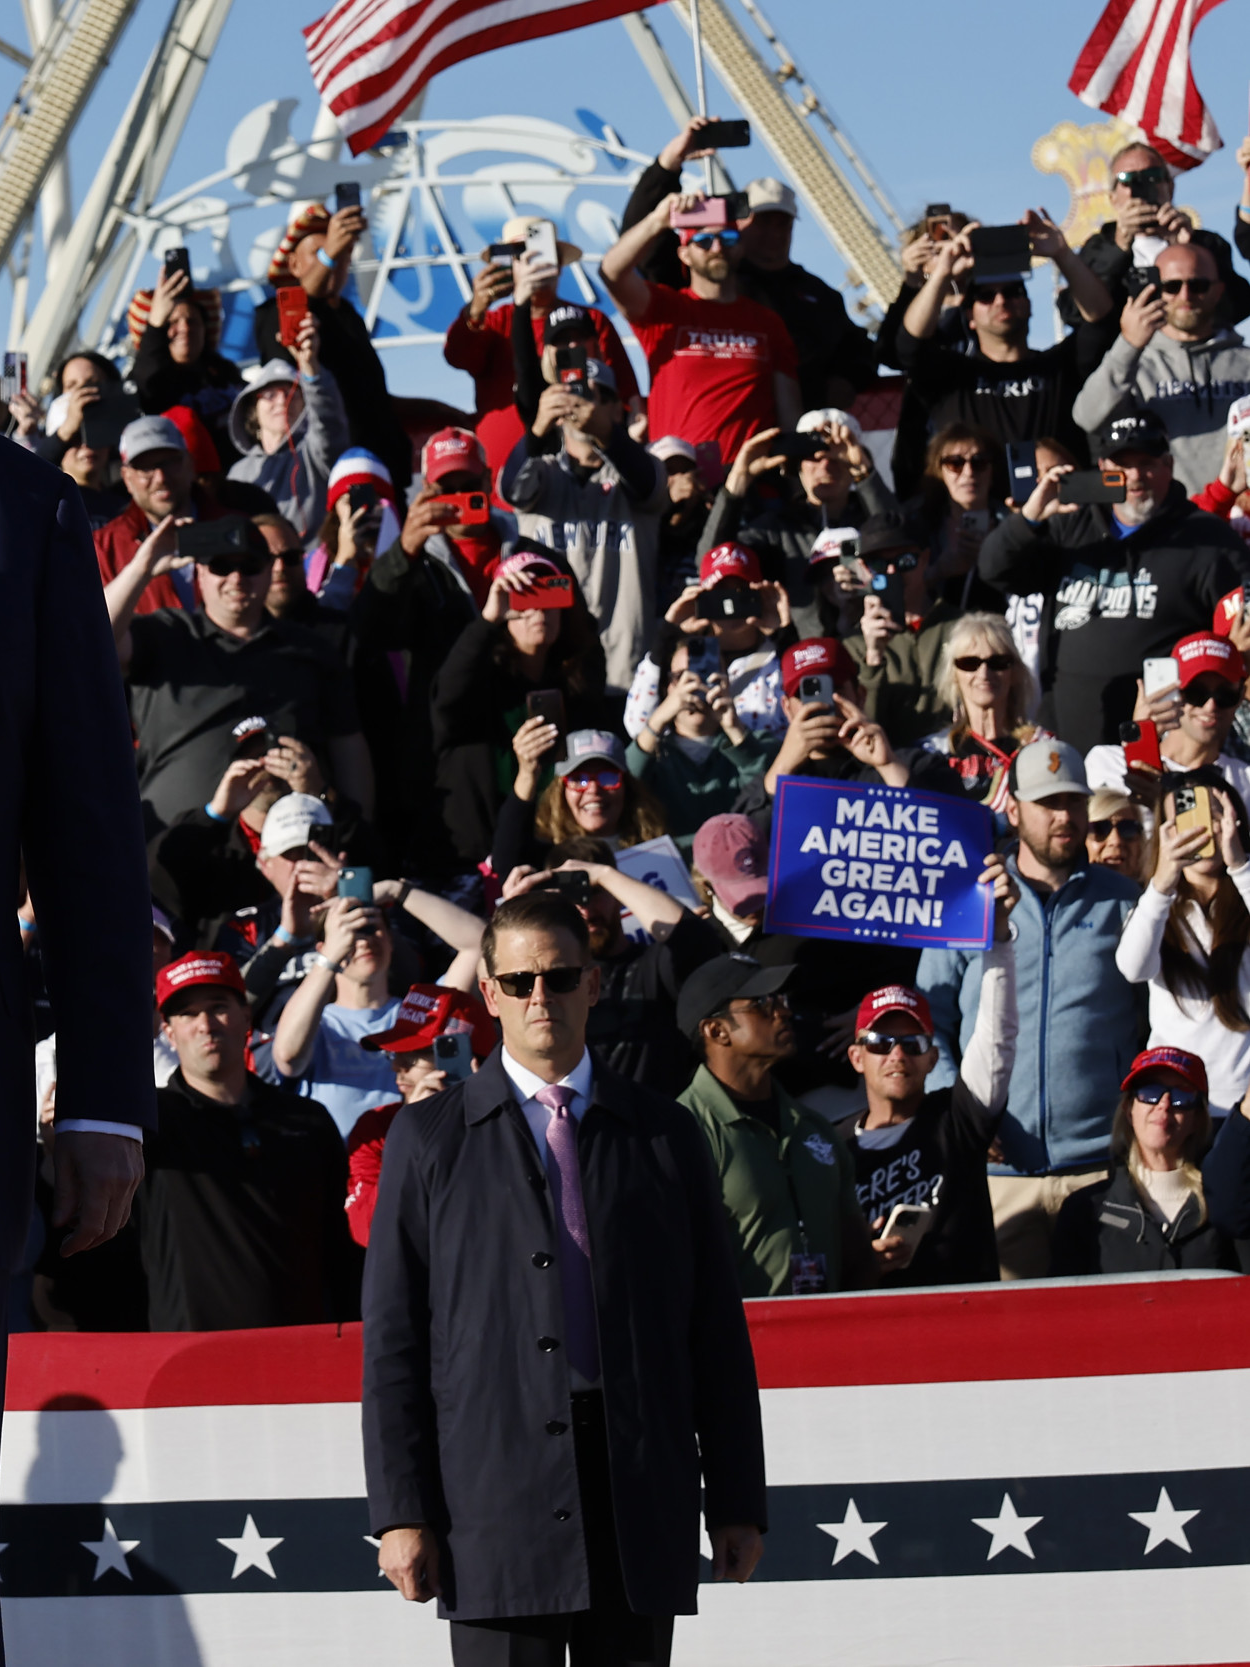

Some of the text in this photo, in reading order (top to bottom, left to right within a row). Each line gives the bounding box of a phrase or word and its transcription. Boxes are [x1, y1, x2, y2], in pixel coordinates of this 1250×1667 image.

[687, 331, 758, 348] TRUMP
[836, 798, 939, 834] MAKE
[800, 826, 968, 868] AMERICA
[821, 859, 945, 895] GREAT
[811, 889, 943, 927] AGAIN!
